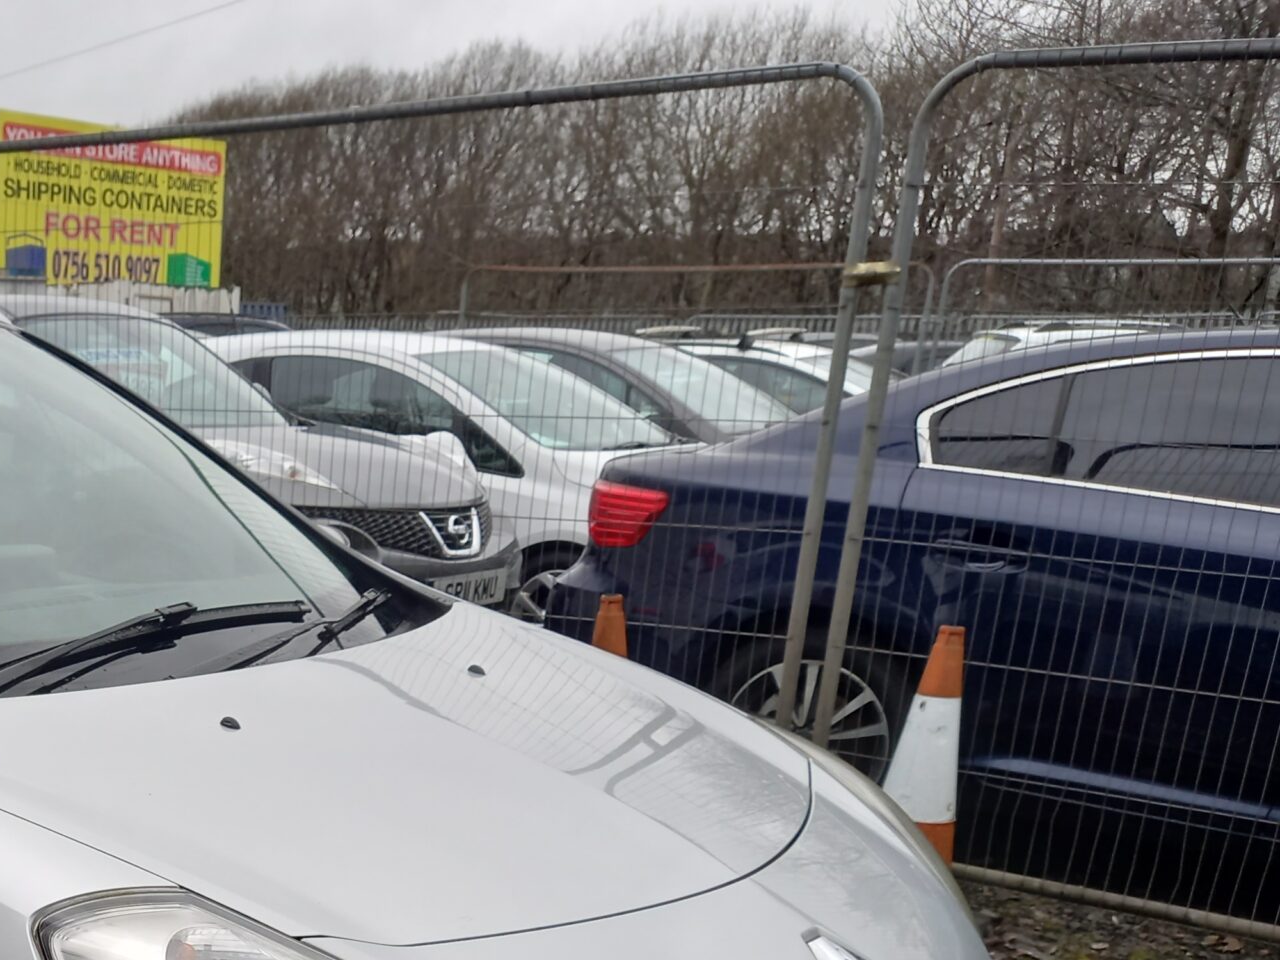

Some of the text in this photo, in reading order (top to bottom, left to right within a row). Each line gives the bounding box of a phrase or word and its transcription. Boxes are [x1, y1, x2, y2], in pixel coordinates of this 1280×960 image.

[14, 158, 218, 195] HOUSEHOLD COMMERCIAL DOMESTIC
[141, 146, 218, 173] ANYTHING
[3, 177, 218, 219] SHIPPING CONTAINERS
[45, 212, 180, 248] FOR RENT
[52, 250, 160, 284] 0756 510 9097
